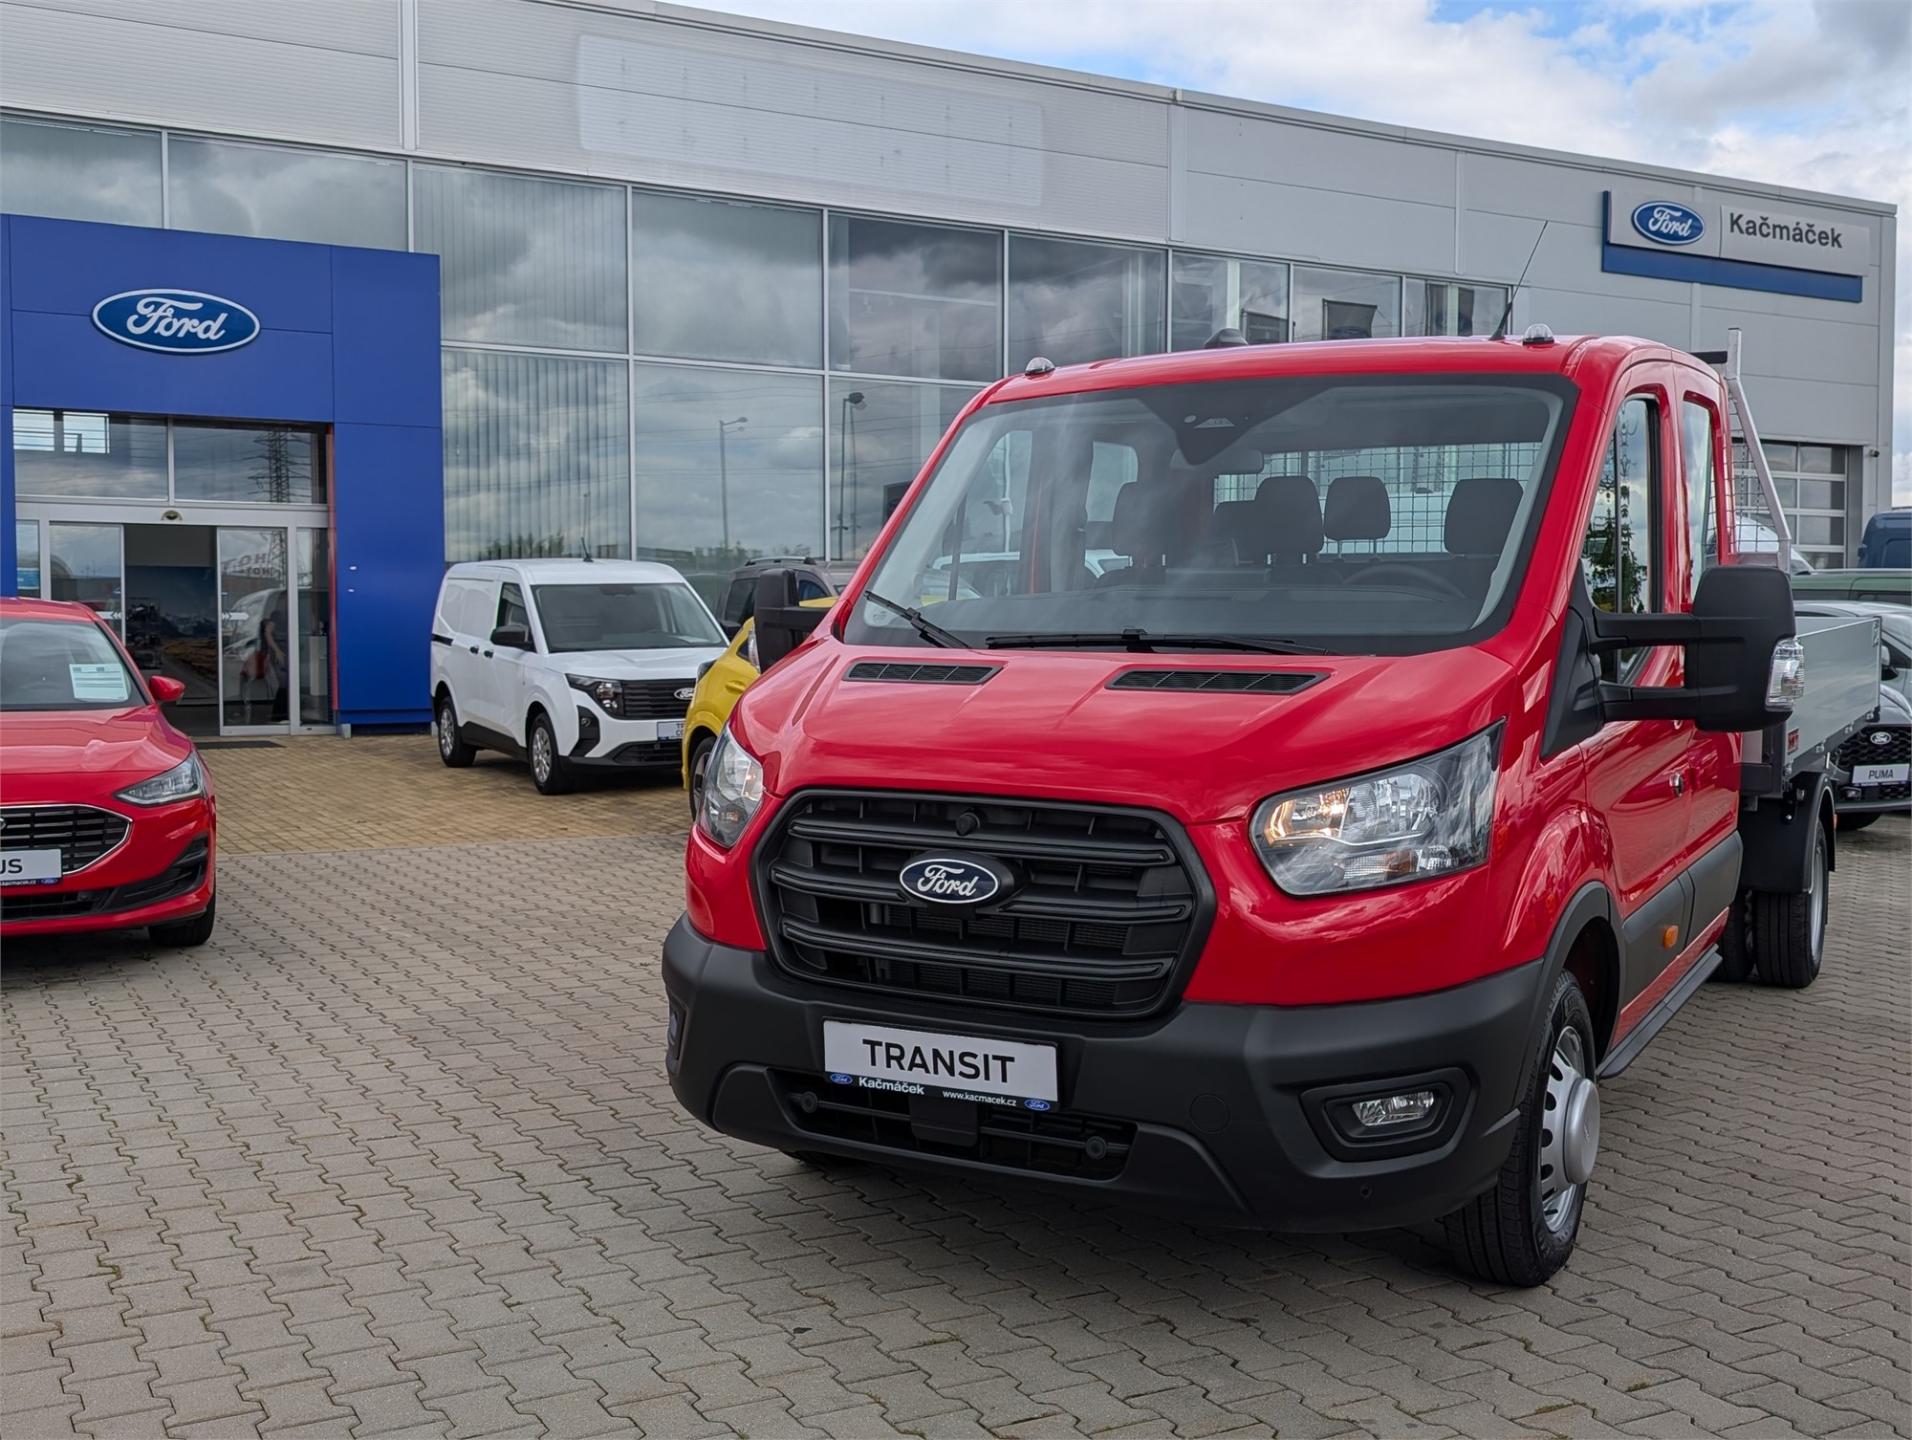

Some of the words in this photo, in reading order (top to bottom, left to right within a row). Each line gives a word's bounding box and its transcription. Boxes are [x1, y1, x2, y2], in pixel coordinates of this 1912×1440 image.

[1648, 207, 1692, 237] Ford
[1729, 211, 1843, 248] Kačmáček
[126, 296, 228, 340] Ford
[1868, 769, 1894, 780] PUMA
[917, 864, 979, 896] Ford
[862, 1038, 1015, 1083] TRANSIT
[858, 1076, 925, 1096] Kačmáček
[942, 1089, 1017, 1107] www.kacmacek.cz
